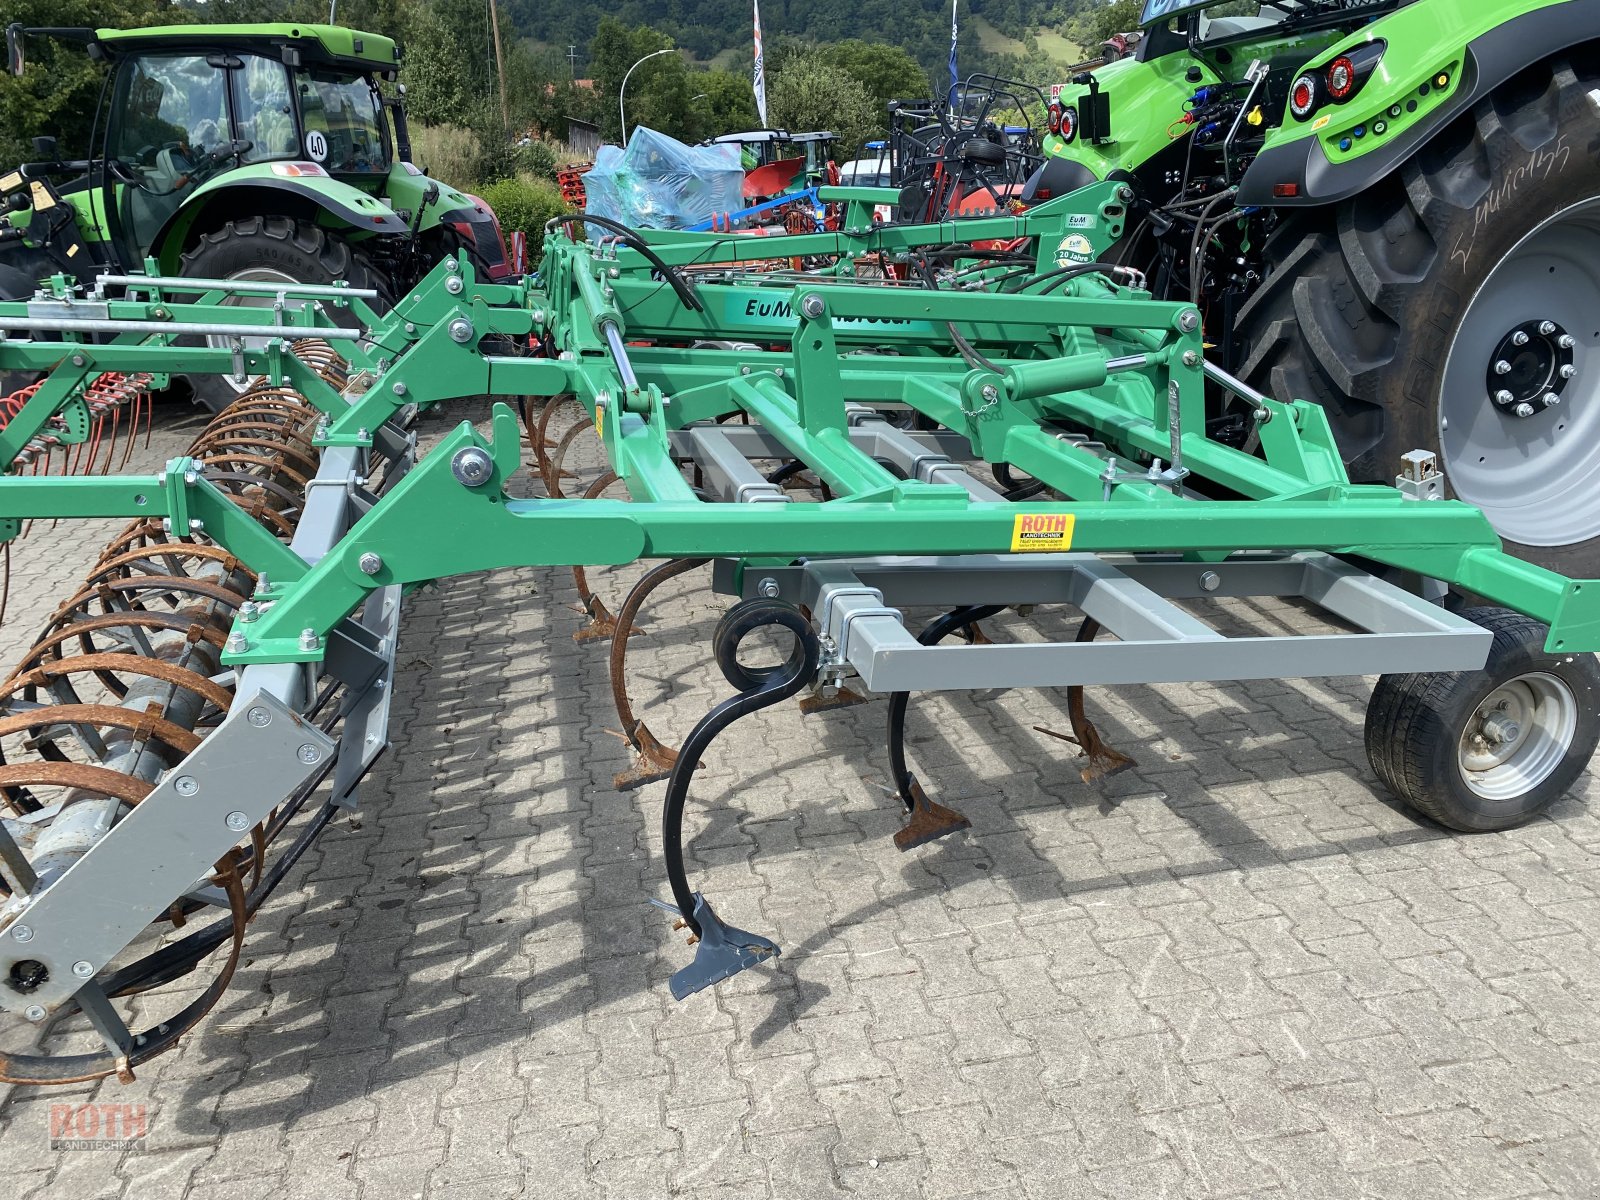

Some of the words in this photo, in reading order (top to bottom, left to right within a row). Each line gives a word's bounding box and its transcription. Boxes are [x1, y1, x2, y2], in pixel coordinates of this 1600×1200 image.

[310, 135, 324, 156] 40
[745, 299, 793, 318] EuM
[1021, 515, 1066, 532] ROTH
